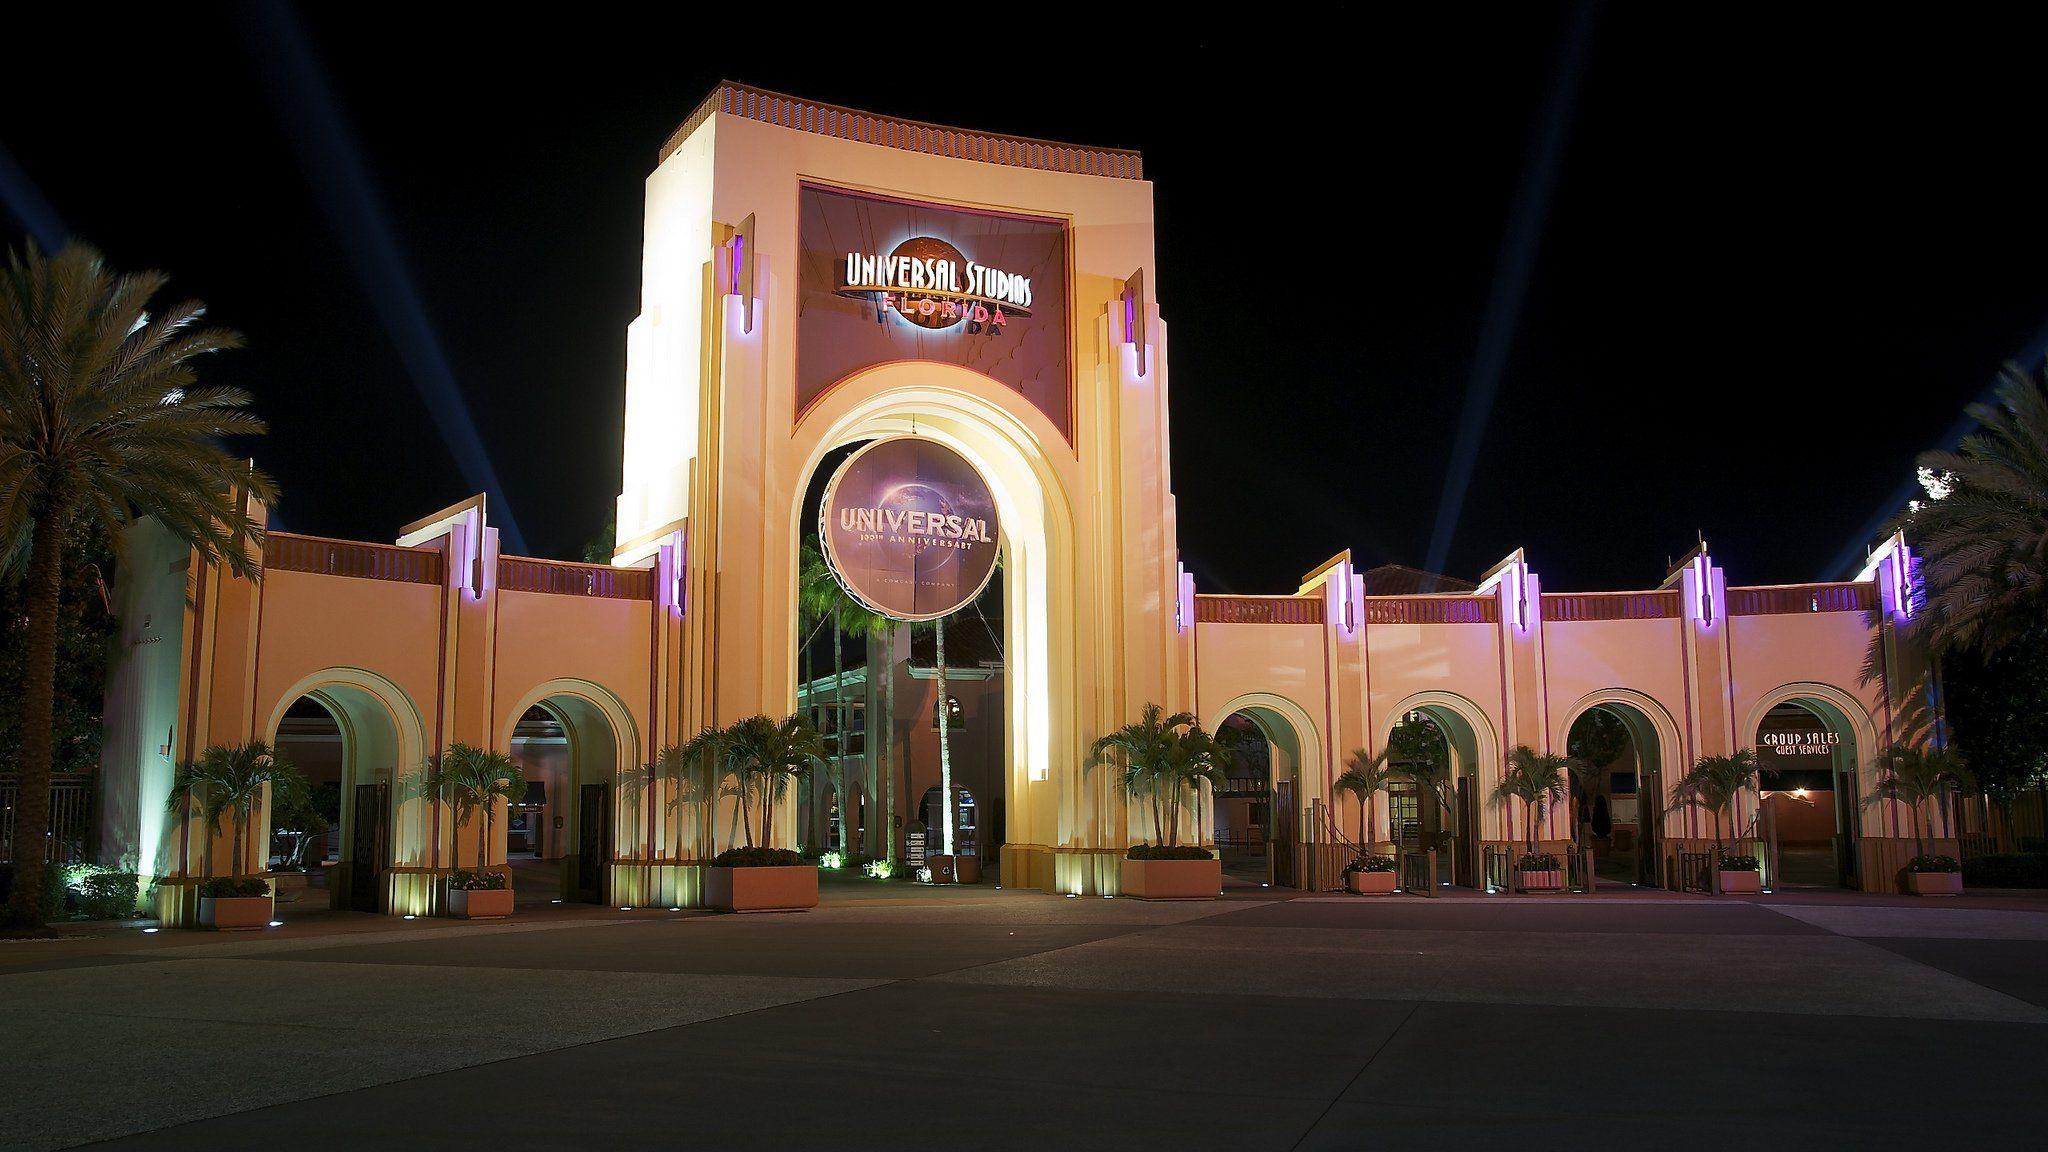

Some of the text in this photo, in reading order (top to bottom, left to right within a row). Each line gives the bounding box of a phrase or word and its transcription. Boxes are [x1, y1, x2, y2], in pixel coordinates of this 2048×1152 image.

[846, 252, 1032, 308] UNIVERSAL STUDIOS
[882, 295, 1007, 326] FLORIDA
[840, 507, 992, 543] UNIVERSAL
[889, 535, 972, 550] ANNIVERSARY
[1763, 732, 1840, 745] GROUP SALES
[1775, 745, 1829, 755] GUEST SERVICES
